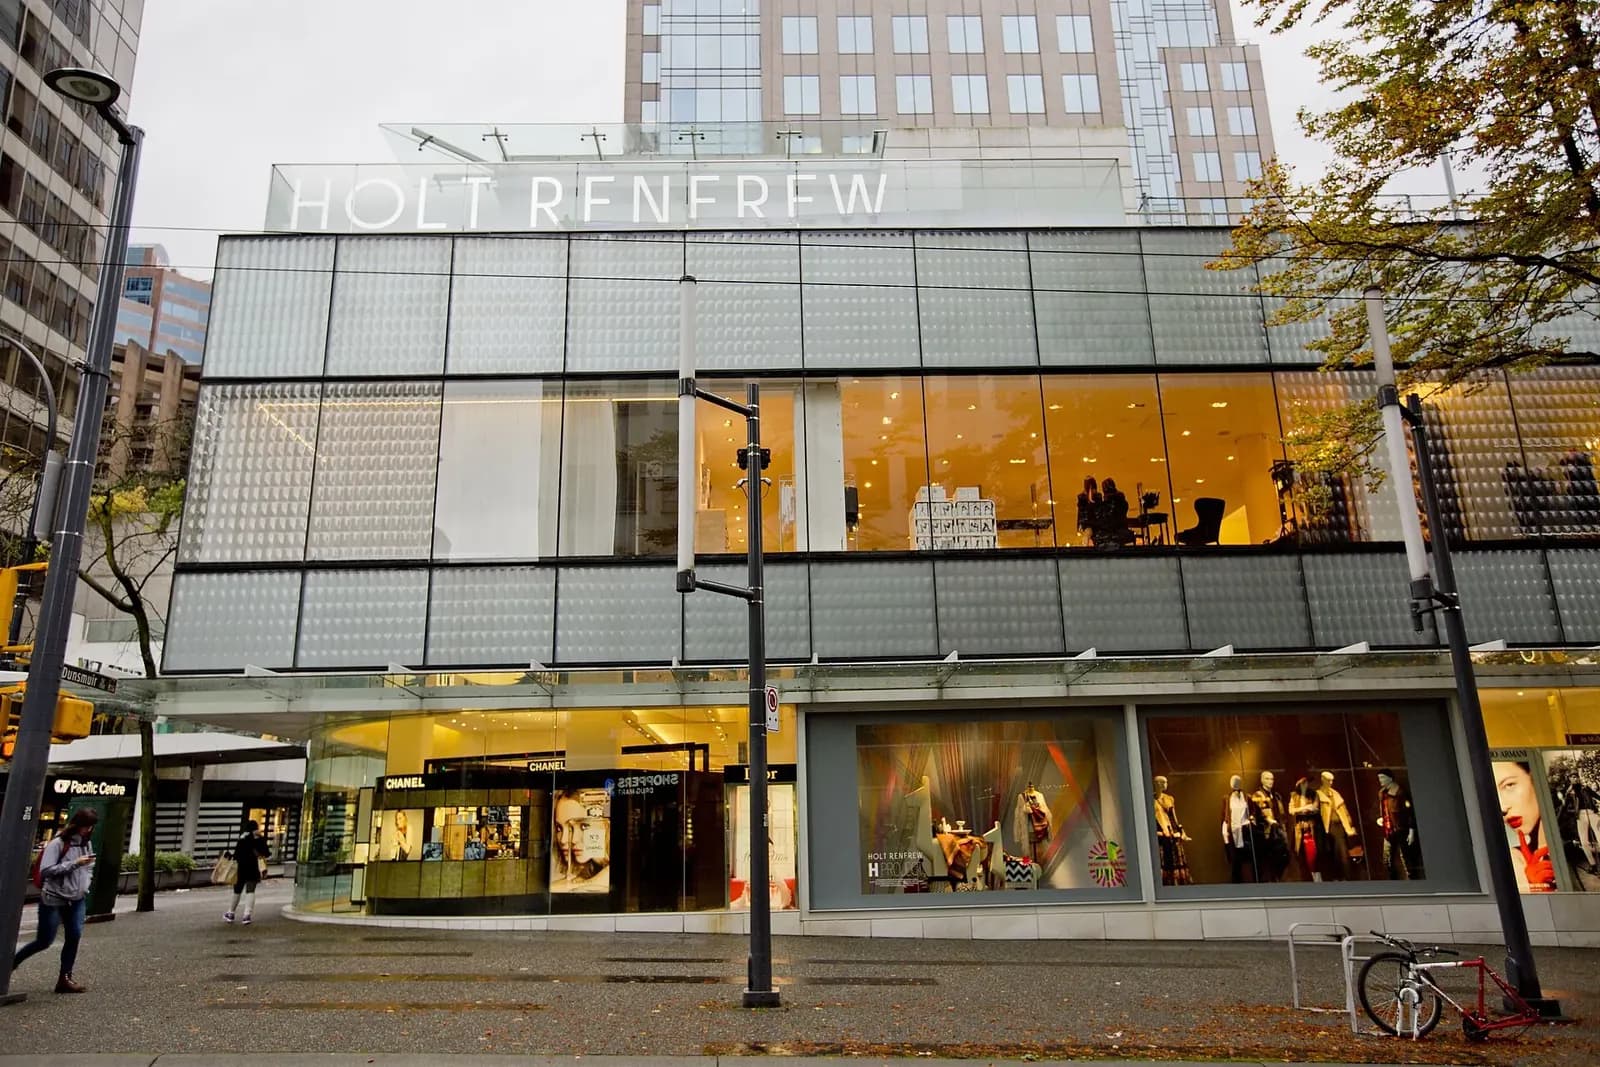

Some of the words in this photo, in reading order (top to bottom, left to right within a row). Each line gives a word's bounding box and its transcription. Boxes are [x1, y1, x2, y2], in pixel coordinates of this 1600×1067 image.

[289, 176, 492, 230] HOLT
[61, 666, 98, 687] Dunsmuir
[529, 761, 566, 772] CHANEL
[71, 780, 98, 795] Pacific
[99, 782, 126, 795] Centre
[386, 776, 425, 790] CHANEL
[889, 851, 922, 860] RENFREW
[868, 862, 879, 877] H
